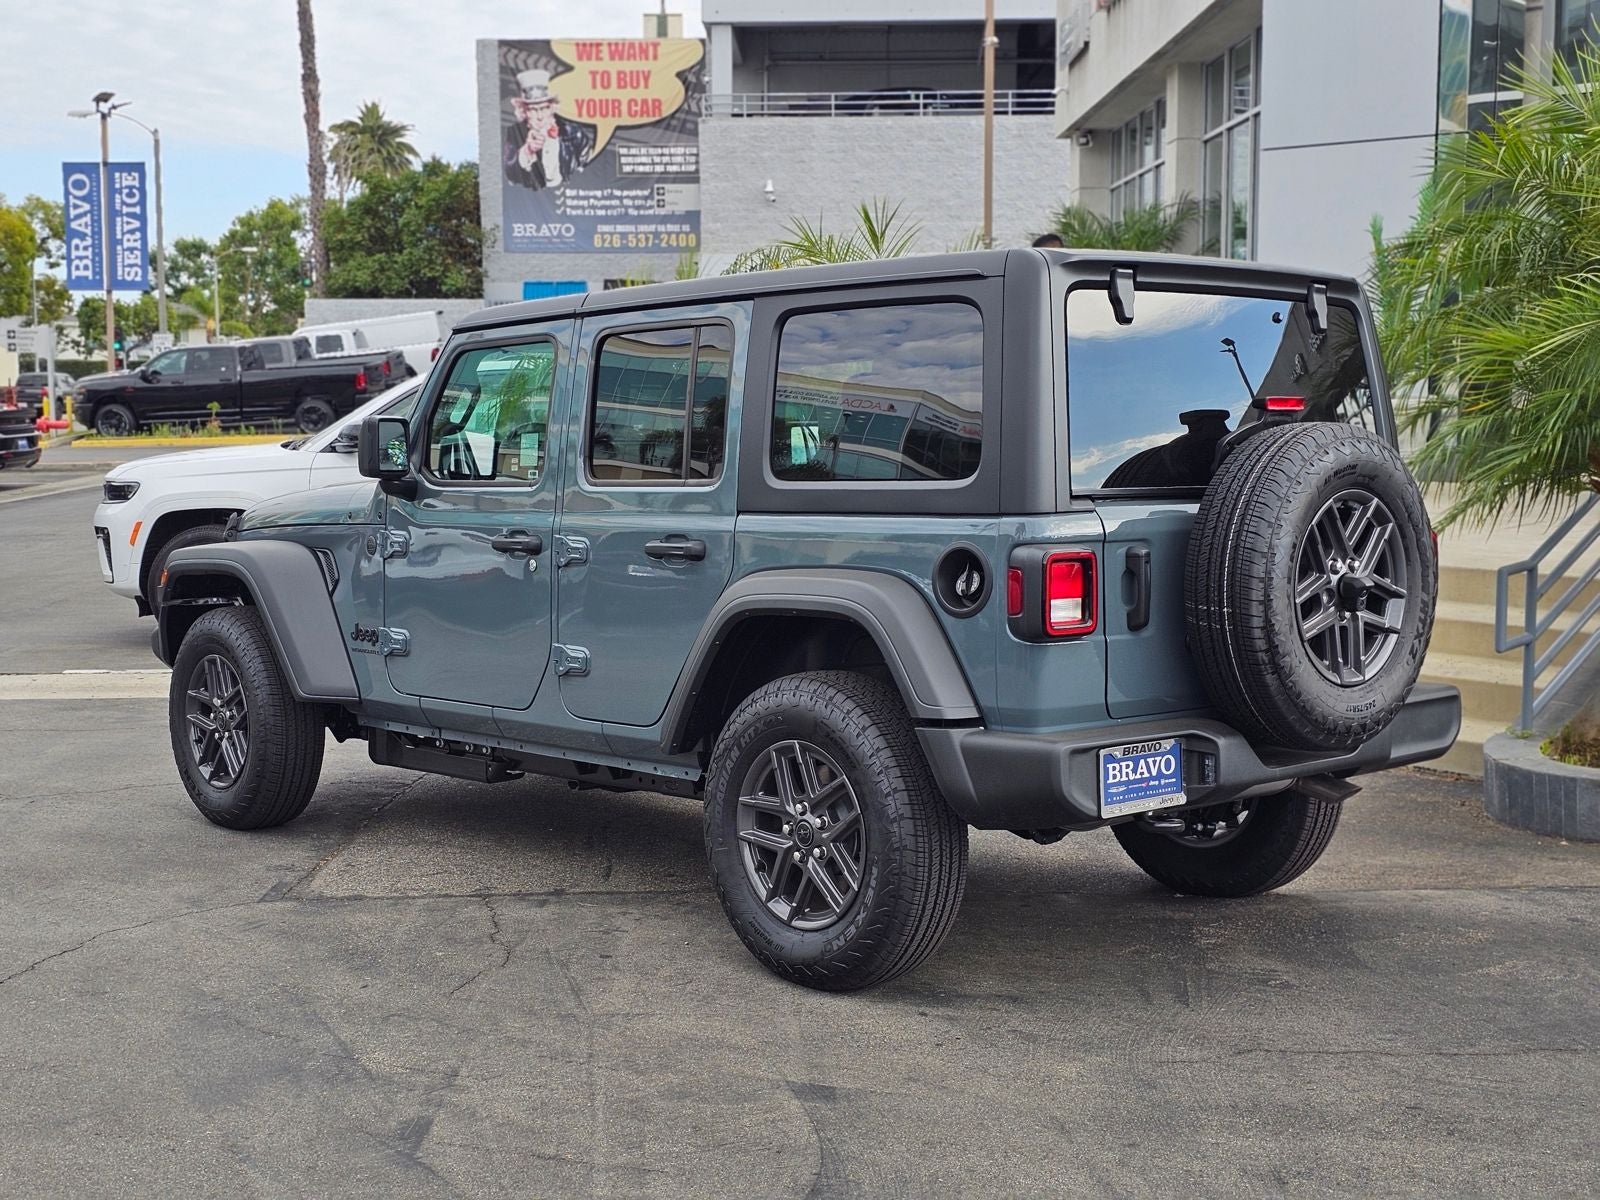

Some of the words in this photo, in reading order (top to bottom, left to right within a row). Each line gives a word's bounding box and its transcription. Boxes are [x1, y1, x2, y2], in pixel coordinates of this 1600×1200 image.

[575, 42, 603, 61] WE
[607, 42, 660, 61] WANT
[589, 70, 611, 89] TO
[616, 70, 651, 89] BUY
[574, 98, 621, 118] YOUR
[627, 98, 662, 118] CAR
[68, 173, 93, 280] BRAVO
[122, 171, 142, 281] SERVICE
[512, 223, 575, 238] BRAVO
[593, 233, 697, 248] 626-537-2400
[351, 622, 379, 646] Jeep
[1122, 741, 1162, 756] BRAVO
[1106, 754, 1176, 784] BRAVO
[828, 864, 879, 952] NEXEN
